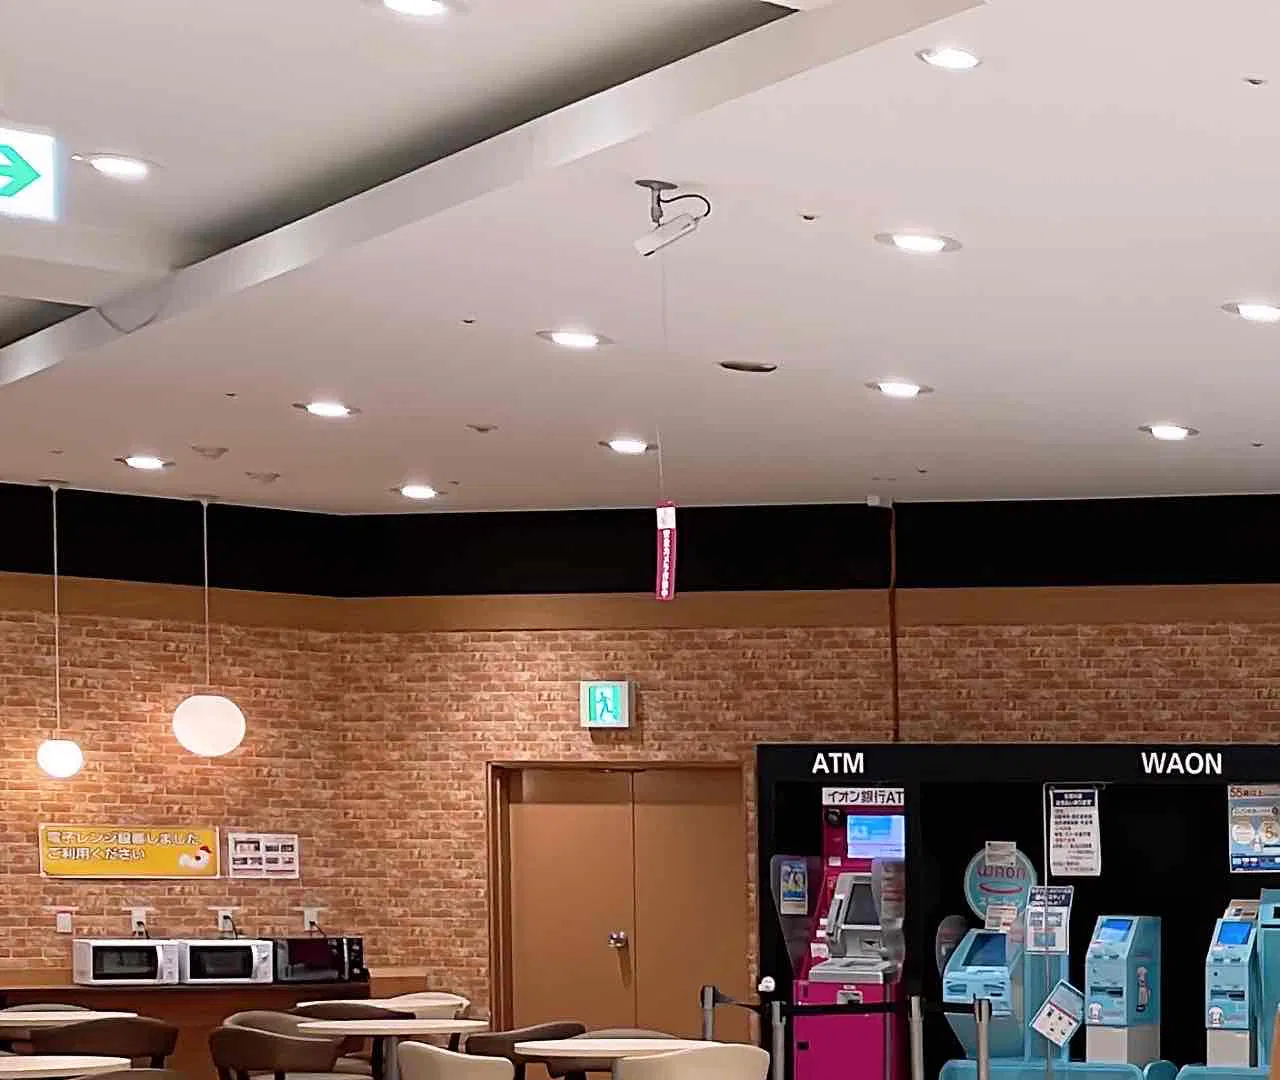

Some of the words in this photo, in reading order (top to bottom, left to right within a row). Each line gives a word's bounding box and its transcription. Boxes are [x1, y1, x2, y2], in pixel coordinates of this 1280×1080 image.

[812, 752, 865, 774] ATM
[1142, 752, 1222, 775] WAON
[48, 847, 145, 861] ご利用ください
